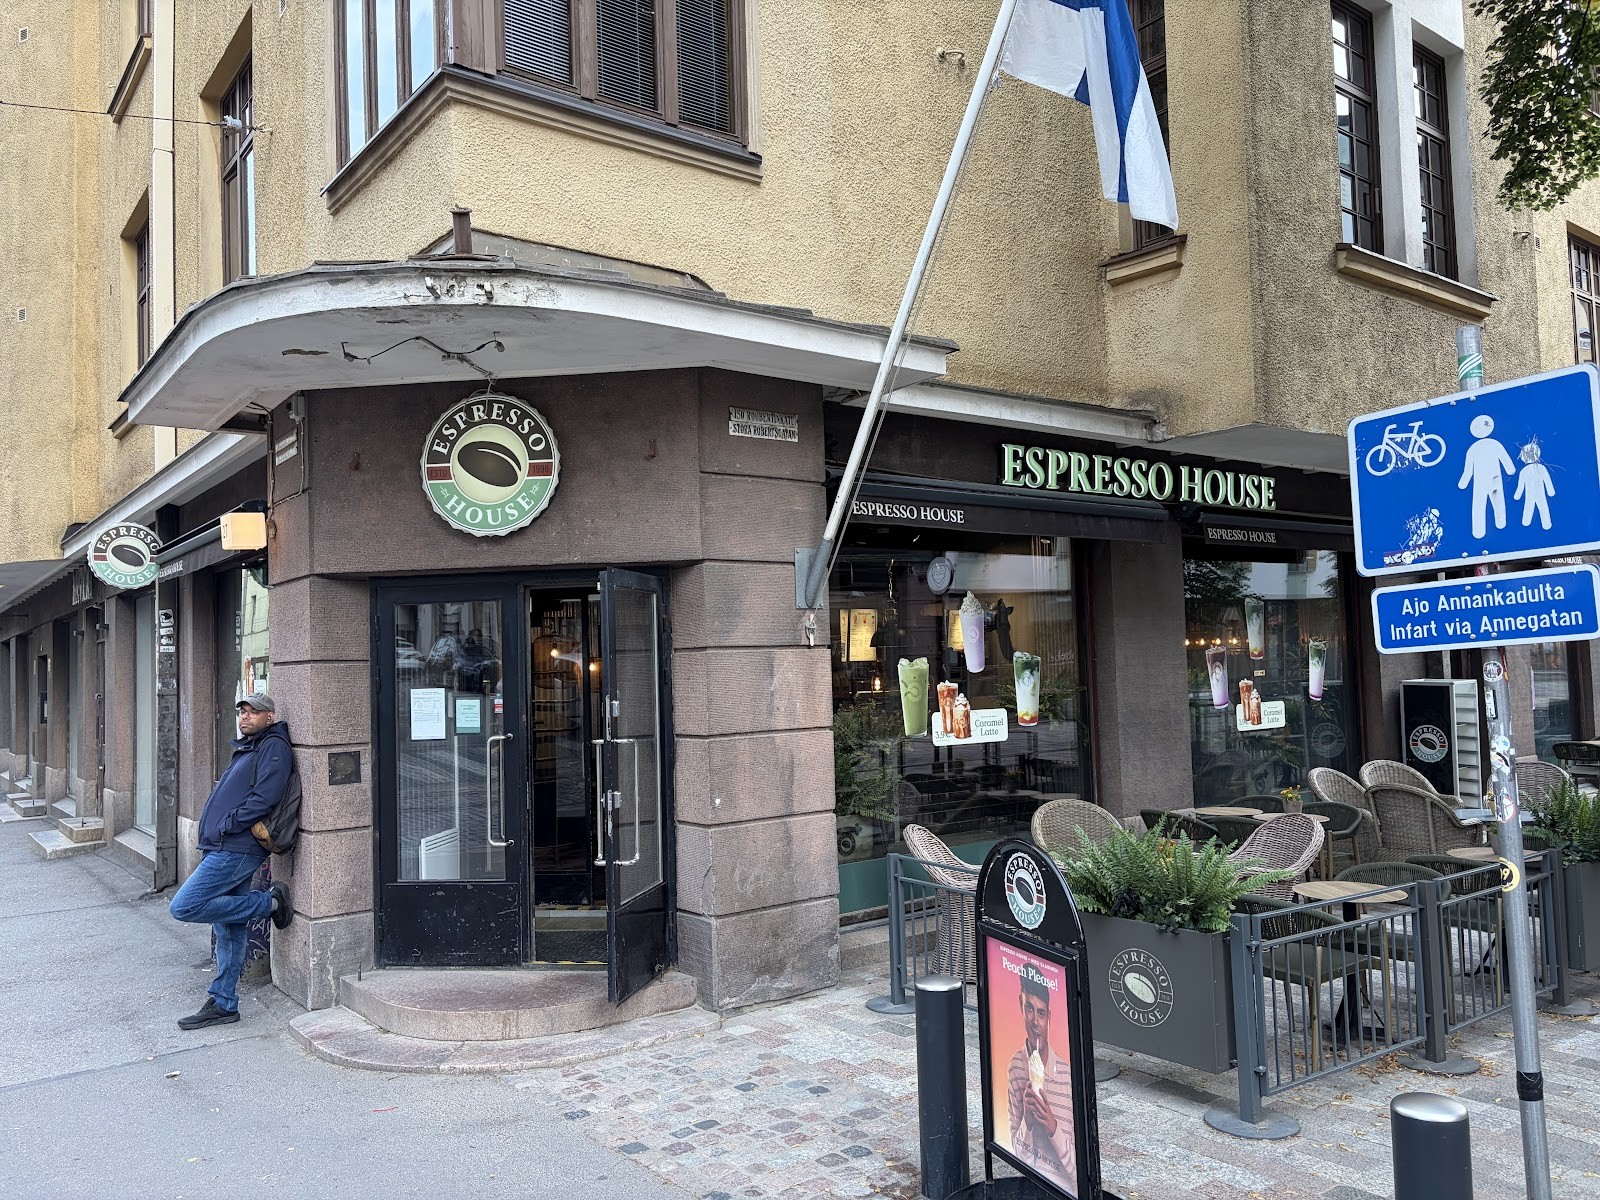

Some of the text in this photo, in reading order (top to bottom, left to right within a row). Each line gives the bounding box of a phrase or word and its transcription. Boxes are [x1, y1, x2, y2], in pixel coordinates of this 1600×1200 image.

[432, 402, 546, 456] ESPRESSO
[732, 423, 752, 435] STORA
[430, 469, 448, 478] ESTD
[532, 464, 550, 474] 1996
[1002, 443, 1277, 511] ESPRESSO HOUSE
[445, 492, 535, 526] HOUSE
[852, 500, 965, 523] ESPRESSO HOUSE
[96, 526, 160, 551] ESPRESSO
[1207, 527, 1277, 543] ESPRESSO HOUSE
[103, 569, 153, 585] HOUSE
[1402, 583, 1566, 618] Ajo Annankadulta
[1390, 609, 1583, 641] Infart via Annegatan
[975, 718, 1004, 728] Caramel
[980, 728, 999, 737] Latte
[1412, 727, 1445, 742] ESPRESSO
[1416, 749, 1443, 760] HOUSE
[1007, 857, 1042, 890] ESPRESSO
[1012, 903, 1040, 924] HOUSE
[1002, 956, 1059, 991] Peach Please!
[1112, 951, 1168, 987] ESPRESSO
[1119, 1000, 1163, 1024] HOUSE
